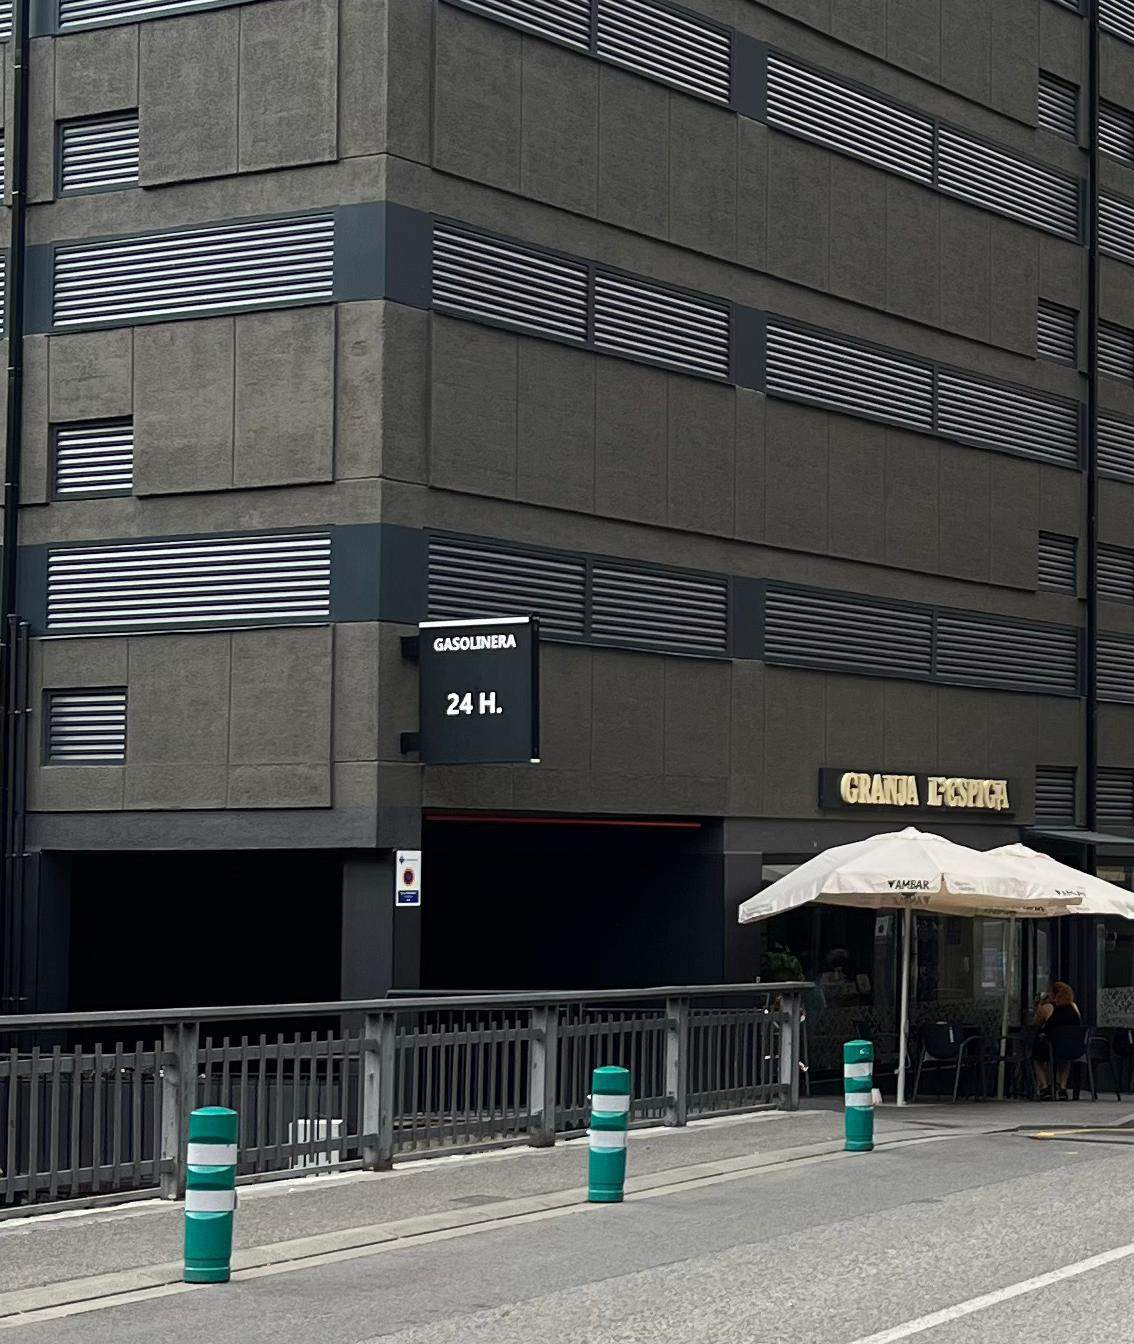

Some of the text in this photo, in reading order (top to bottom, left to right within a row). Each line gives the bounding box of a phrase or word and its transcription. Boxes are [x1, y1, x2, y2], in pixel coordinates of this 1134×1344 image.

[433, 634, 517, 652] GASOLINERA
[446, 691, 503, 715] 24 H.
[840, 771, 920, 806] GRANJA
[894, 879, 930, 890] AMBAR
